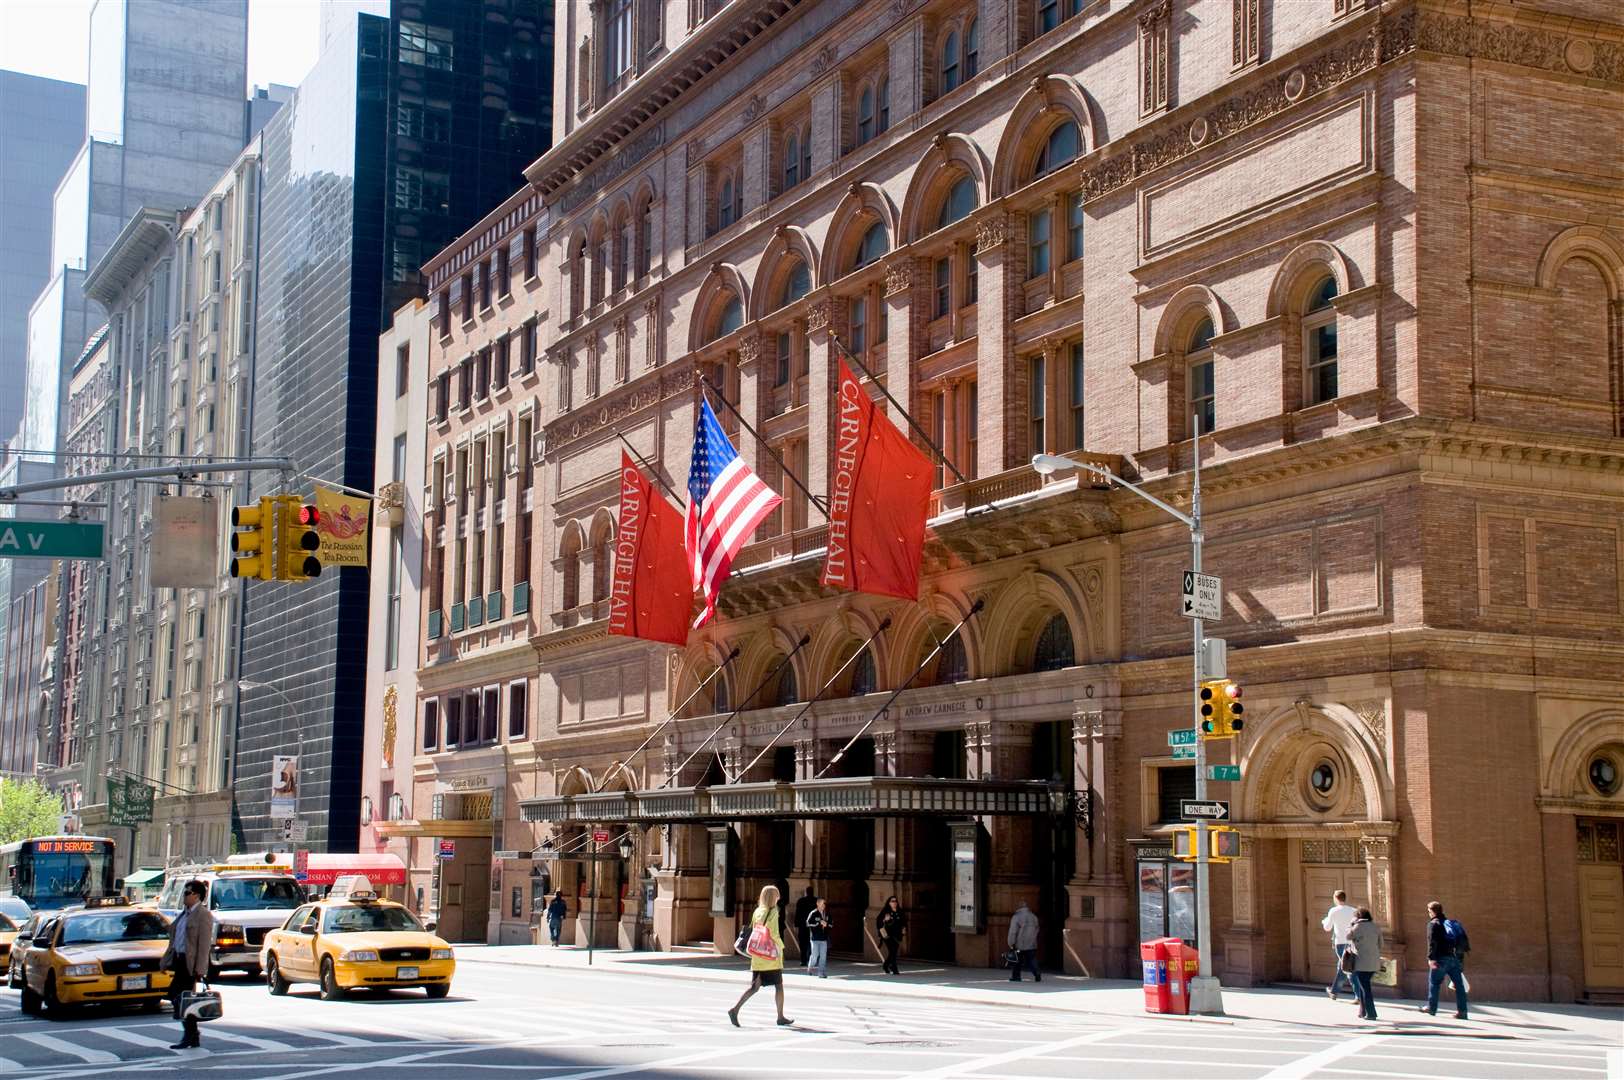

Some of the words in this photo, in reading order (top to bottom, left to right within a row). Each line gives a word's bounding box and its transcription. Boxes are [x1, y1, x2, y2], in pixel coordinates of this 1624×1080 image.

[834, 378, 862, 513] CARNEGIE
[615, 467, 639, 575] CARNEGIE
[0, 527, 45, 550] Av
[321, 541, 332, 550] The
[334, 542, 363, 551] Russian
[824, 519, 848, 585] HALL
[323, 552, 335, 561] Tea
[336, 553, 360, 562] Room
[1197, 577, 1217, 589] BUSES
[1199, 590, 1216, 600] ONLY
[905, 705, 932, 717] ANDREW
[934, 701, 967, 713] CARNEGIE
[1180, 732, 1189, 743] 57
[1221, 767, 1228, 779] 7
[1188, 806, 1202, 814] ONE
[1208, 806, 1223, 815] WAY
[38, 842, 52, 852] NOT
[54, 842, 63, 851] IN
[64, 842, 95, 851] SERVICE
